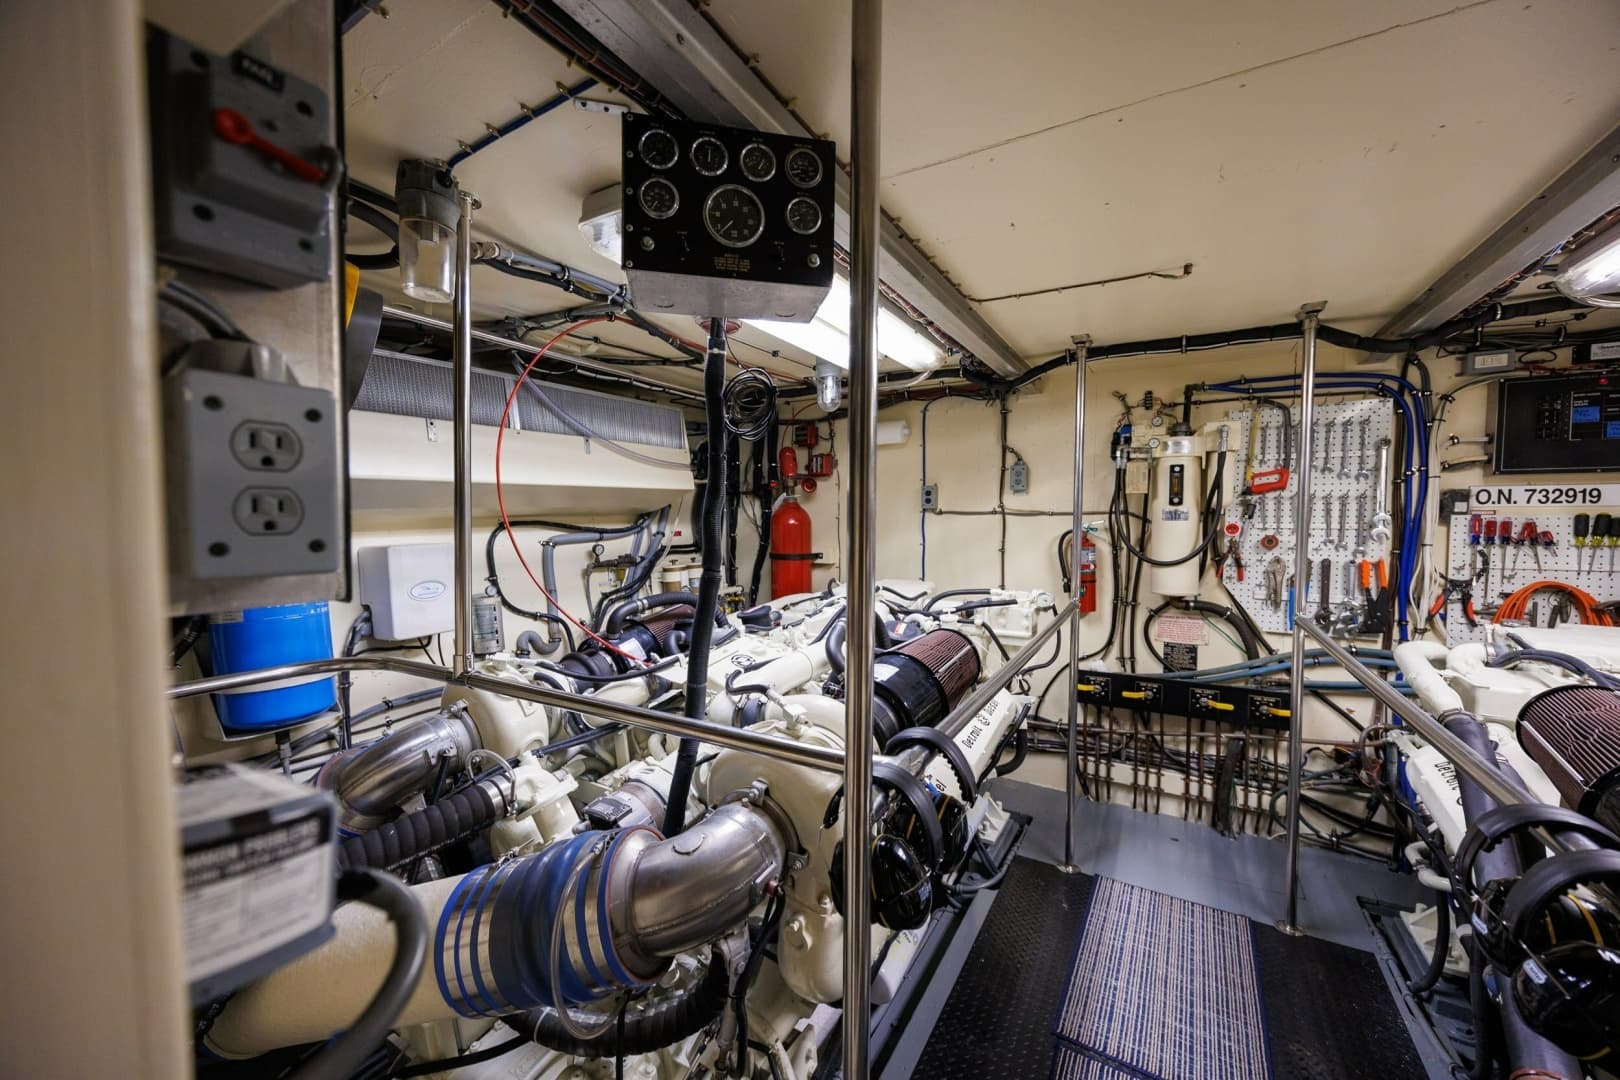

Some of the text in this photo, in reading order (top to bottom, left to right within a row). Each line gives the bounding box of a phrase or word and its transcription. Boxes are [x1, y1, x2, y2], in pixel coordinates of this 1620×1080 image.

[1475, 487, 1602, 505] O.N. 732919
[961, 725, 984, 749] Detroit
